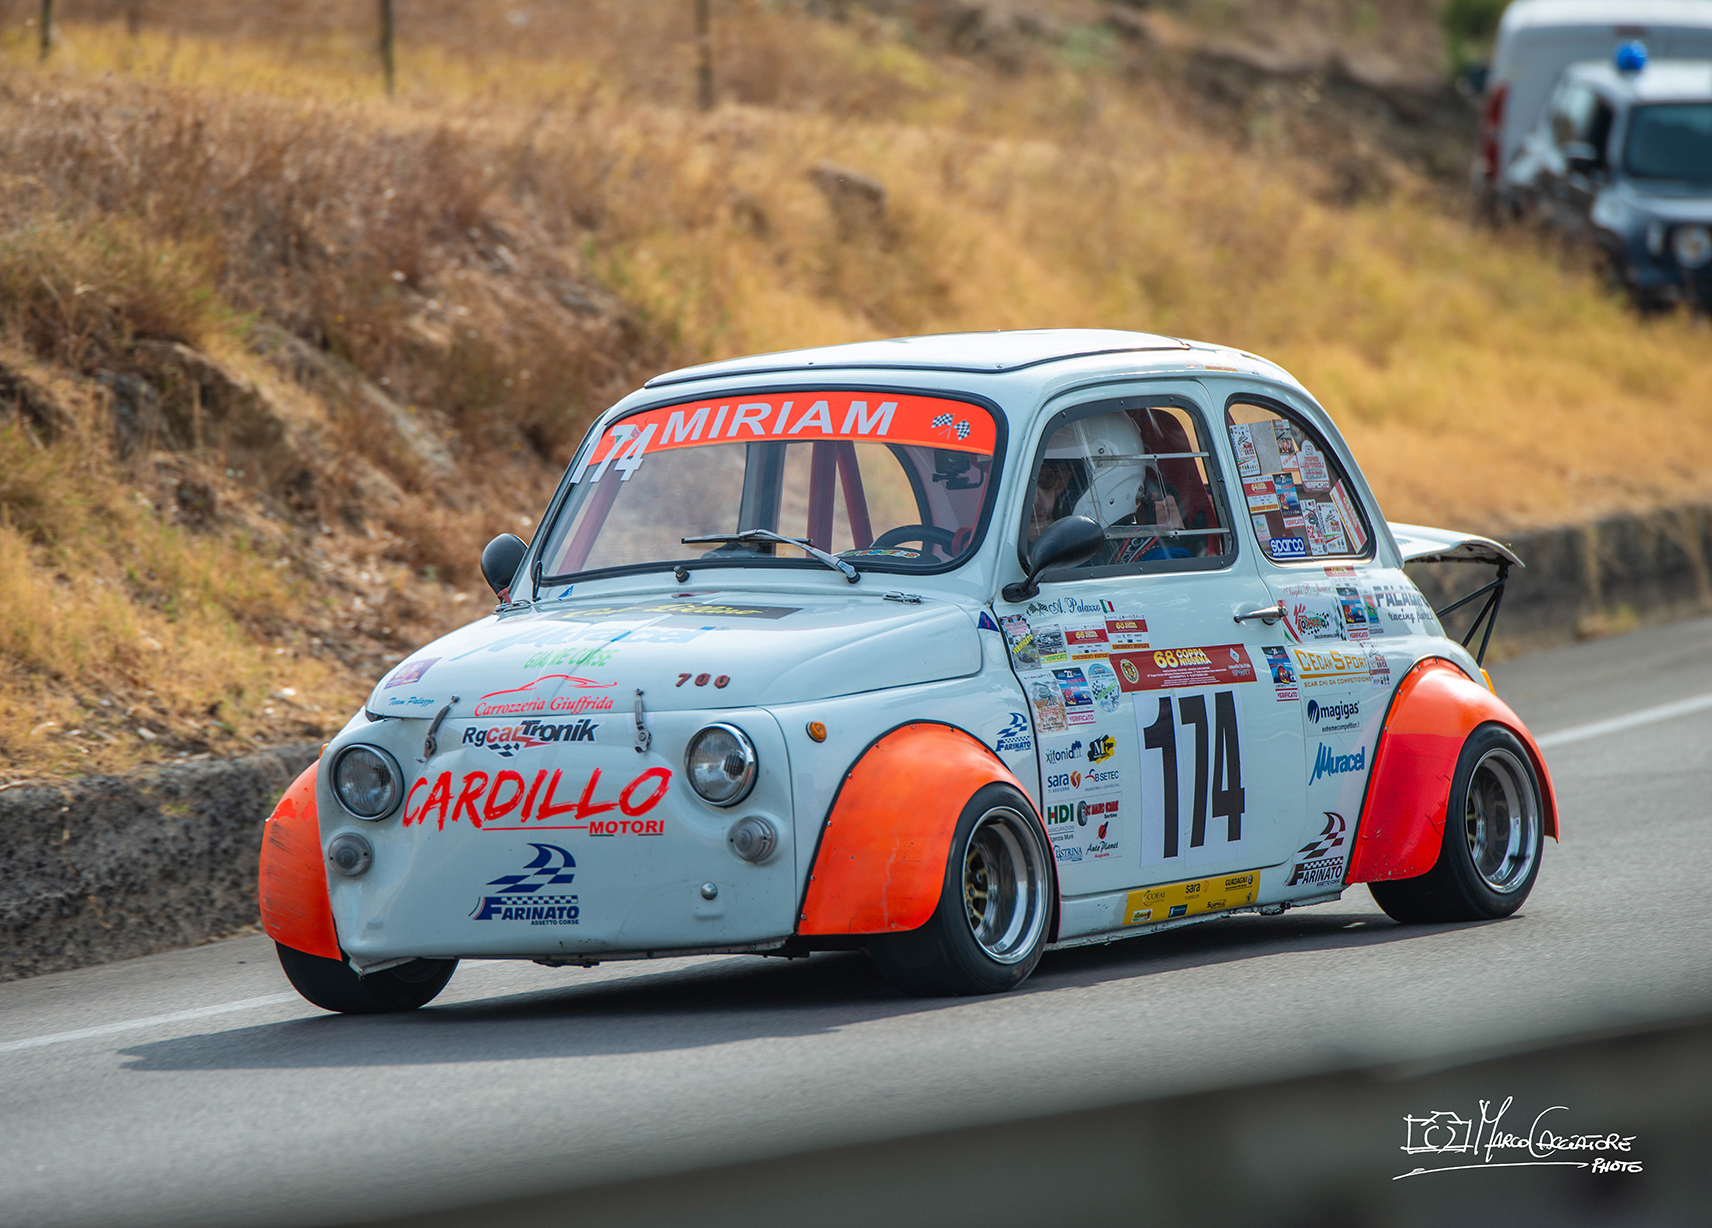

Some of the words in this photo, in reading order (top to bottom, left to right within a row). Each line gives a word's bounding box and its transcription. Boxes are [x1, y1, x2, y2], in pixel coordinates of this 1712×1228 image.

[659, 400, 899, 445] MIRIAM
[570, 423, 659, 484] 174
[1271, 539, 1304, 556] sparco
[1175, 648, 1207, 660] COPPA
[675, 672, 731, 689] 700
[474, 697, 546, 717] Carrozzeria
[550, 696, 614, 714] Giuffrida
[1320, 701, 1359, 720] magigas
[995, 740, 1031, 752] FARINATO
[1143, 690, 1246, 859] 174
[1309, 742, 1365, 786] Muracel
[1047, 773, 1070, 788] sara
[403, 767, 673, 832] CARDILLO
[1047, 803, 1075, 825] HDI
[589, 820, 665, 834] MOTORI
[1288, 864, 1343, 886] FARINATO
[1185, 882, 1201, 894] sara
[474, 897, 580, 920] FARINATO
